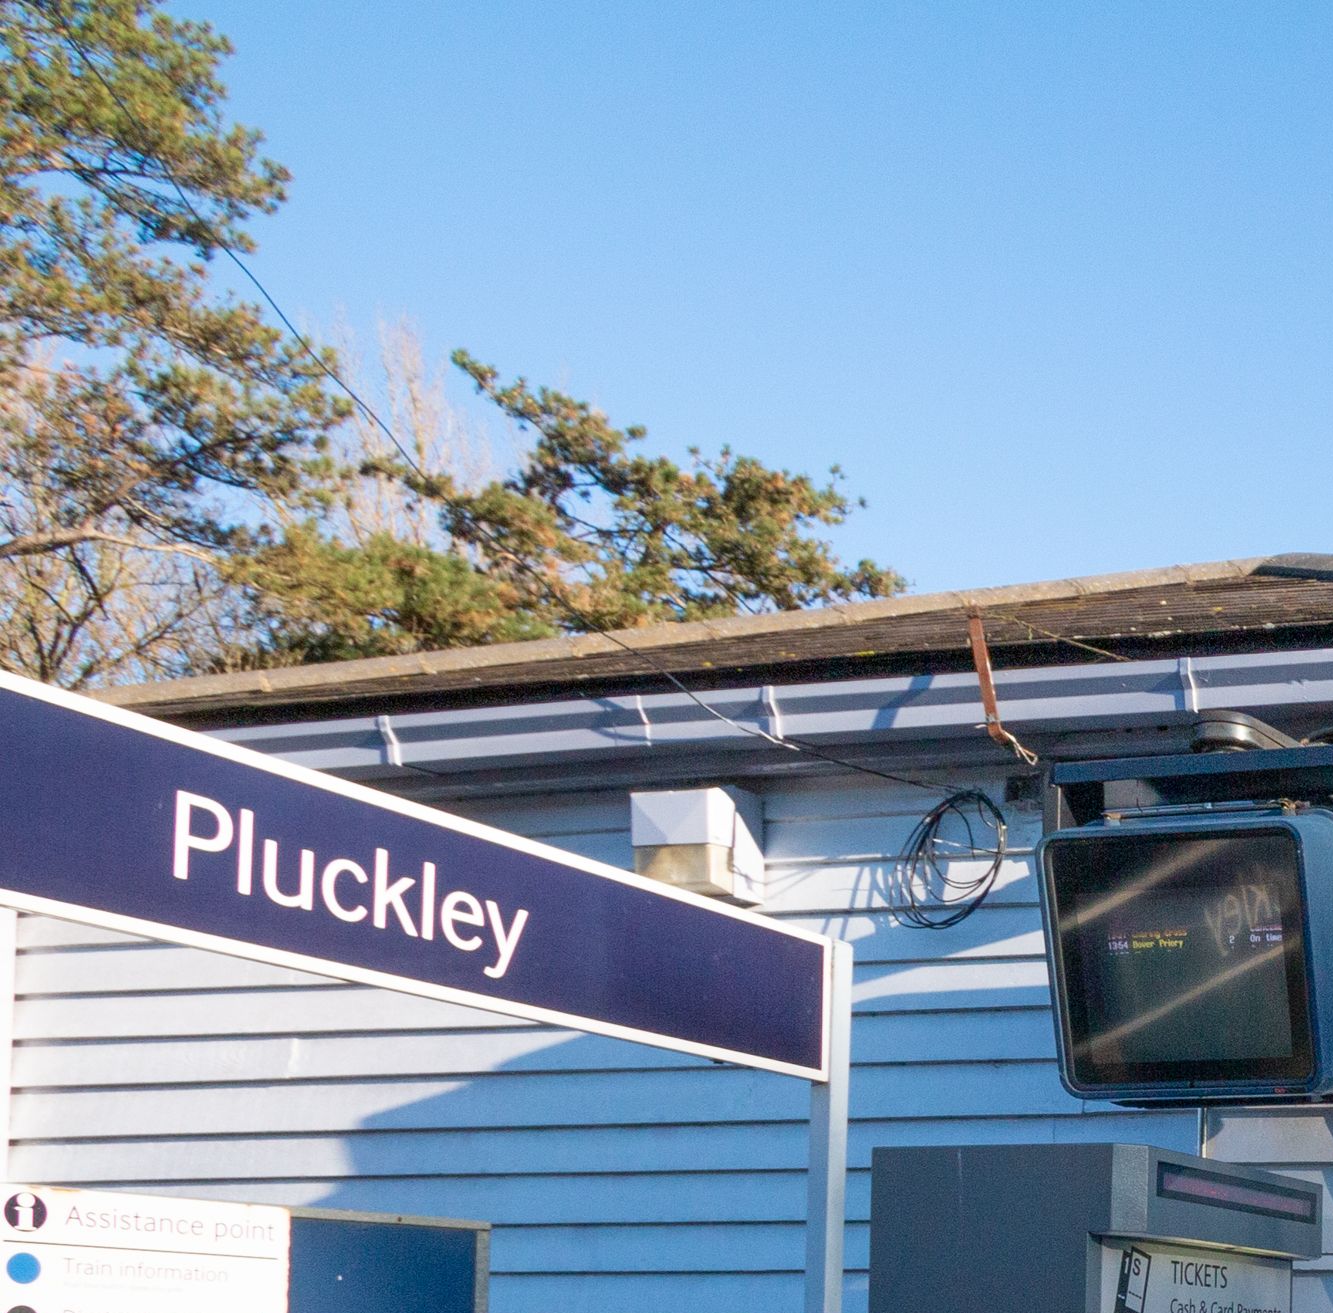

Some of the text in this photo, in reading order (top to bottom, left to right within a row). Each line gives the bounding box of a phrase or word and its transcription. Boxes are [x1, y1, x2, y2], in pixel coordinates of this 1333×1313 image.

[173, 788, 528, 980] Pluckley
[1250, 934, 1261, 943] On
[65, 1205, 276, 1243] Assistance point
[63, 1257, 229, 1283] Train information
[1171, 1260, 1228, 1289] TICKETS
